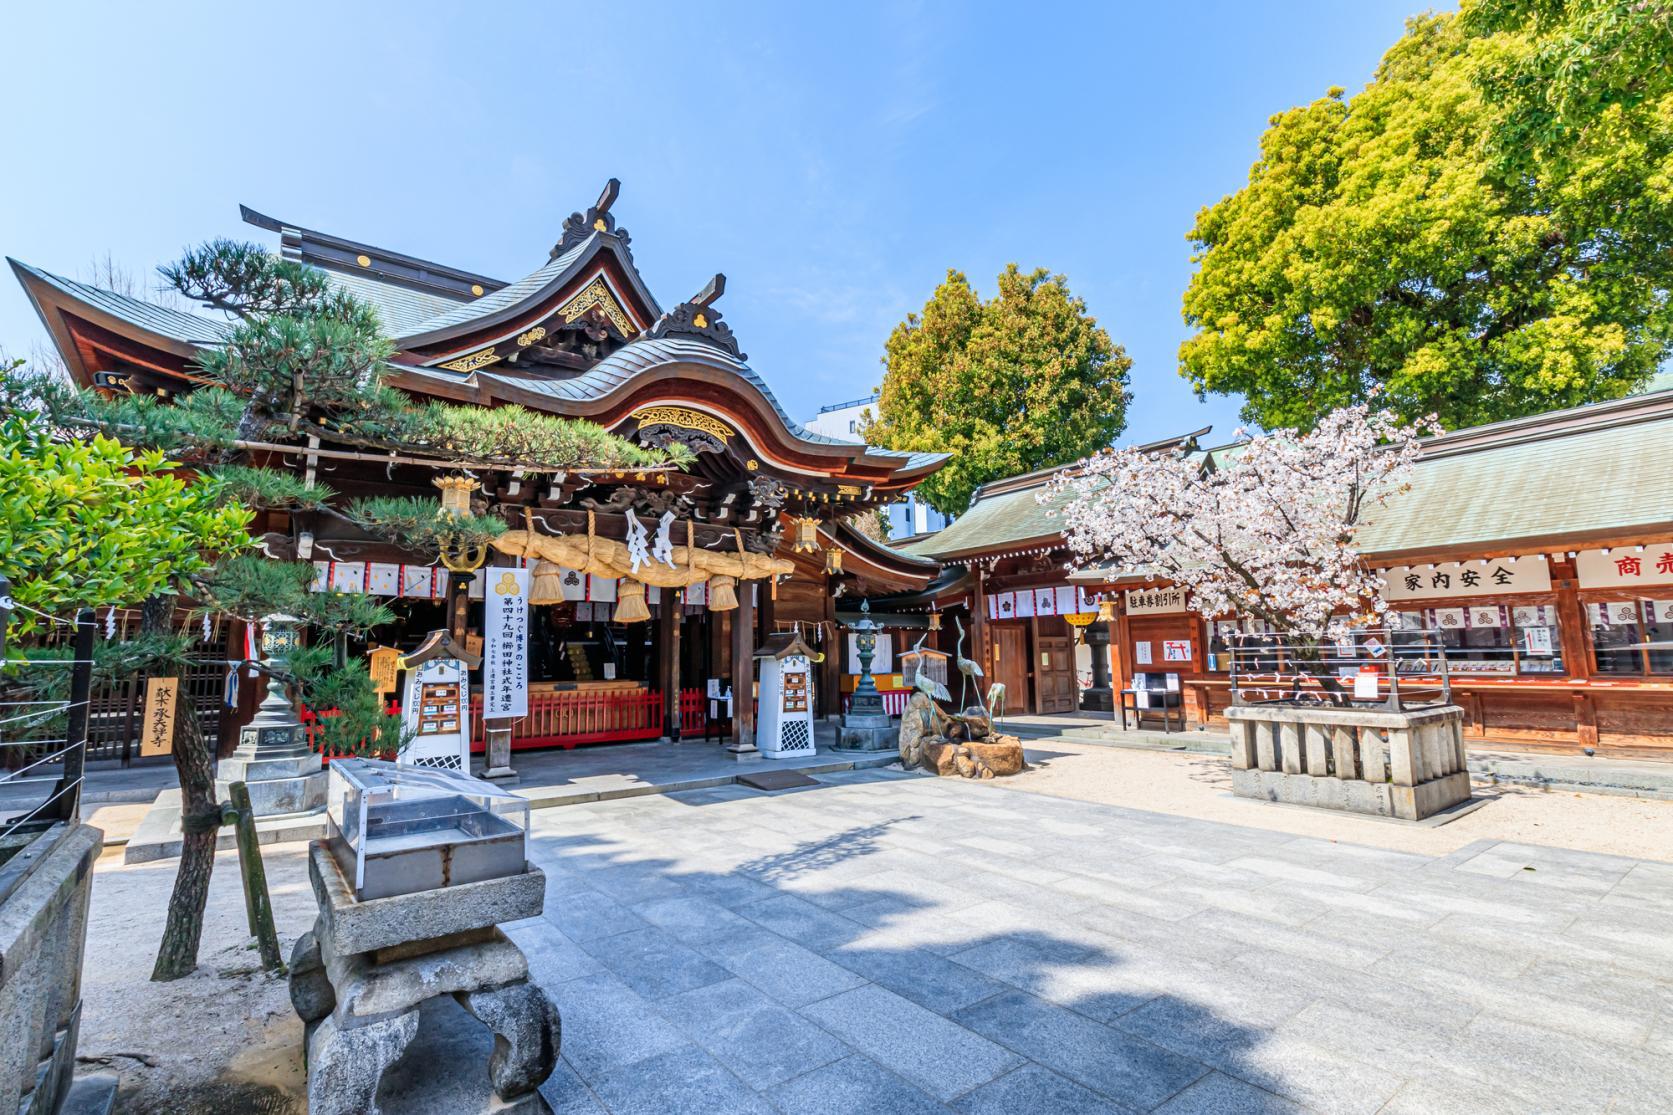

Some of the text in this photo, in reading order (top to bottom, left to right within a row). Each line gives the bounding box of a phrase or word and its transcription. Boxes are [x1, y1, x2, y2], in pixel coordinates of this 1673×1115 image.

[1614, 552, 1673, 577] 商売
[1404, 566, 1515, 591] 家内安全
[515, 596, 524, 690] うけつぐ博多のこころ
